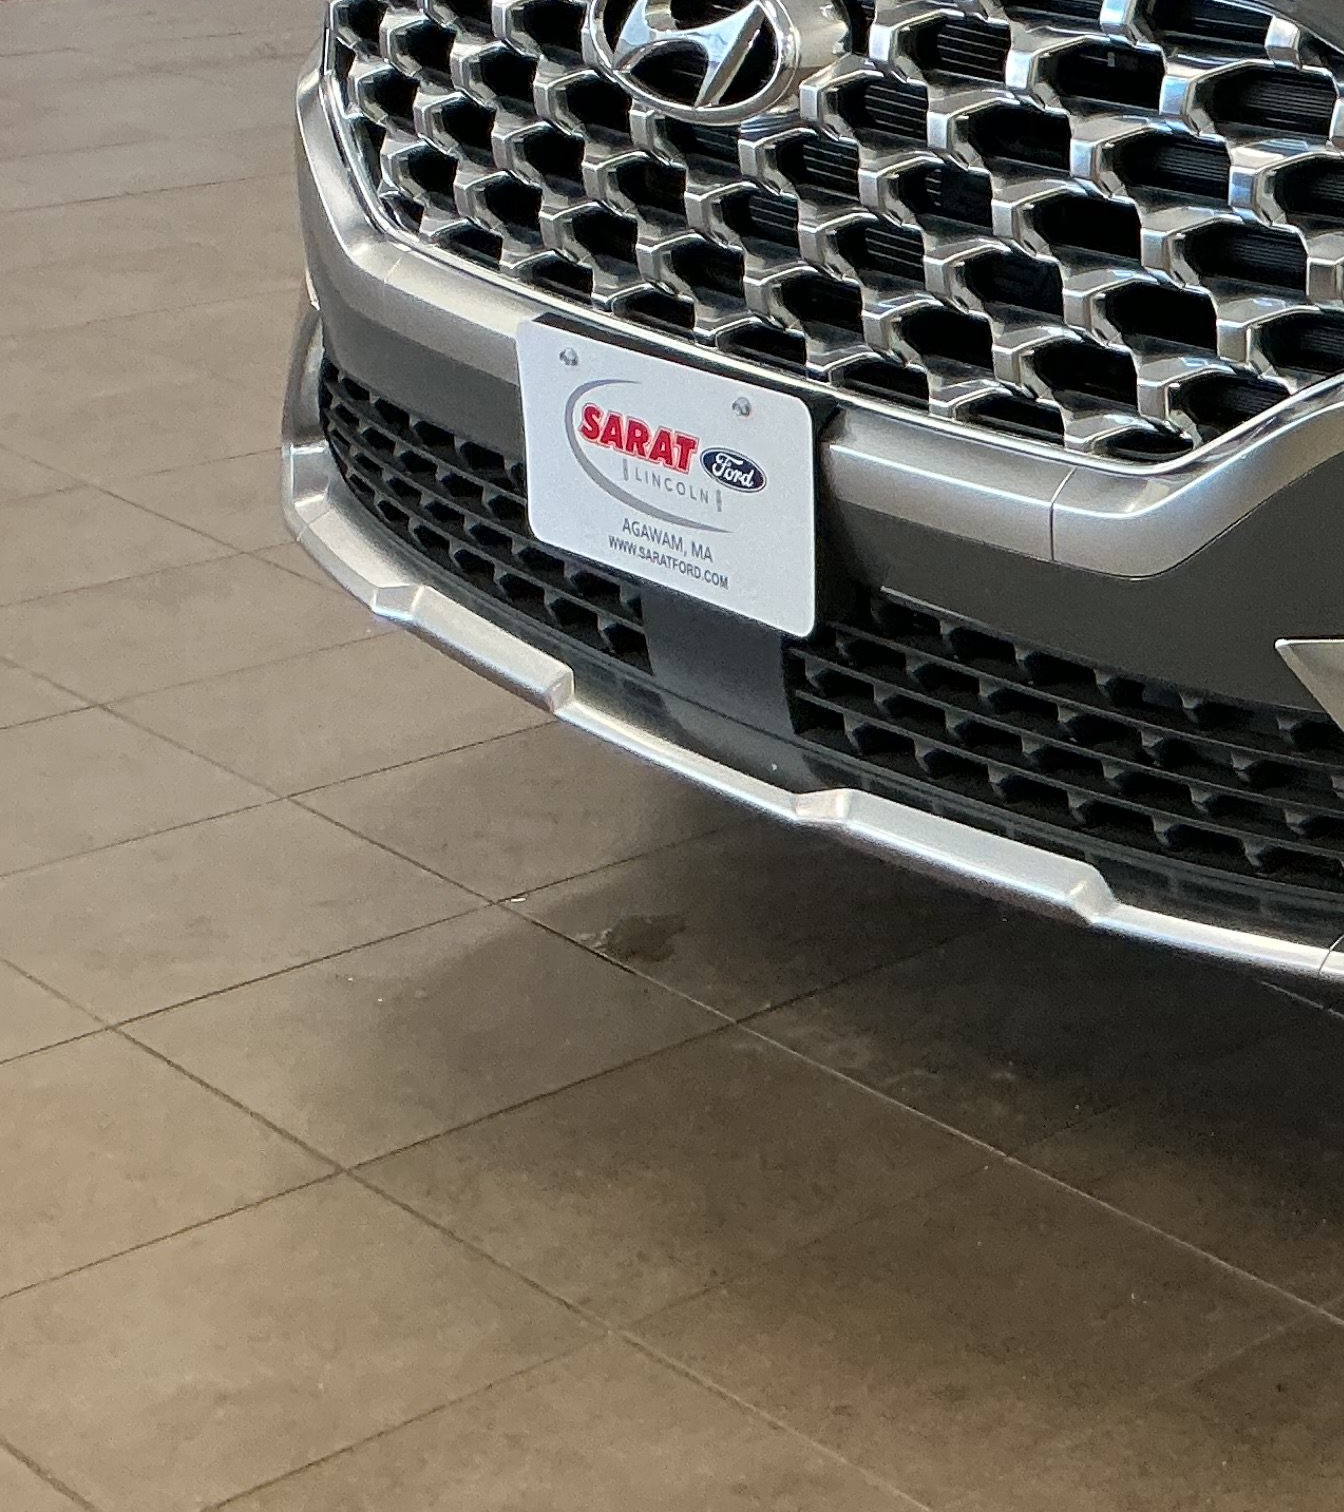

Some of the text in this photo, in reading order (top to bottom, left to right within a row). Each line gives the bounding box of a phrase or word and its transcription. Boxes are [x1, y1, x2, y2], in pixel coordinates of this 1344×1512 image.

[579, 402, 756, 489] SARAT Ford
[634, 466, 710, 504] LINCOLN
[607, 534, 730, 590] WWW.SARATFORD.COM
[621, 517, 714, 563] AGAWAM, MA
